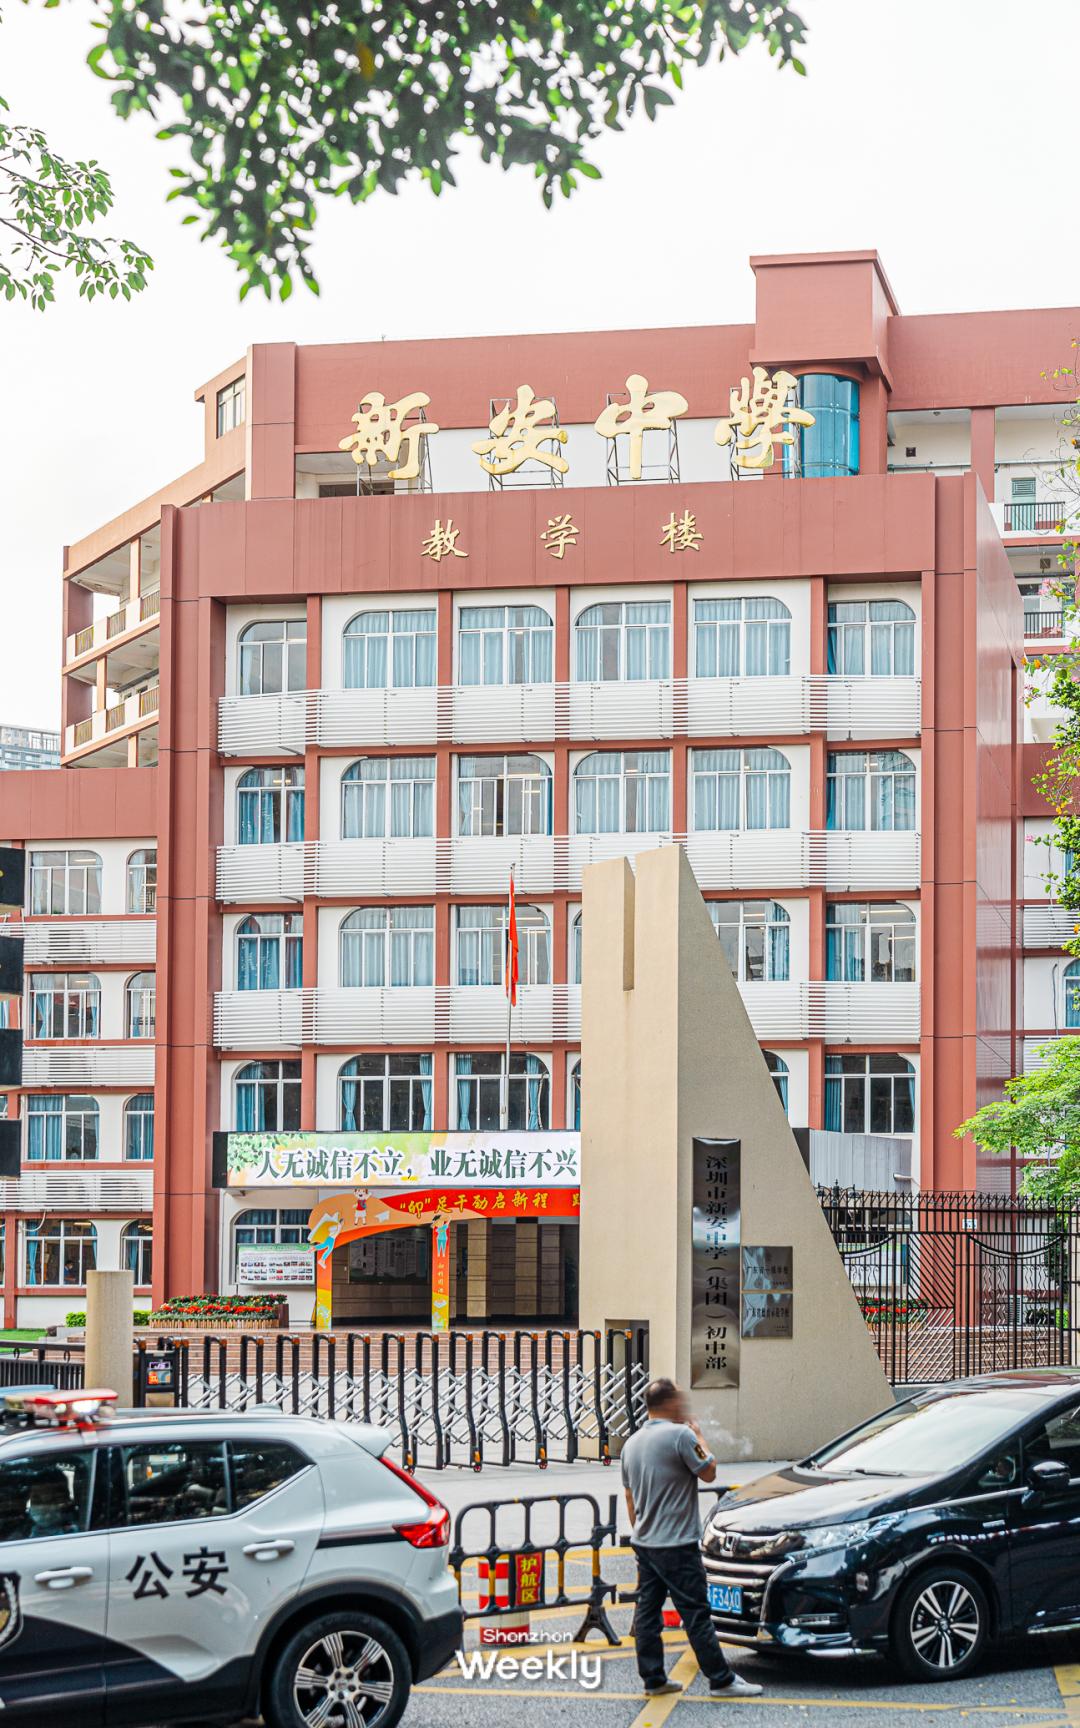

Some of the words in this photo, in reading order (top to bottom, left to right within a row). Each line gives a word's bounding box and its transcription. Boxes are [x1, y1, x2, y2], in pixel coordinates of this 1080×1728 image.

[419, 509, 705, 563] 教学楼
[255, 1147, 580, 1181] 人无诚信不立，业无诚信不兴
[125, 1546, 229, 1600] 公安
[520, 1555, 539, 1603] 护航区
